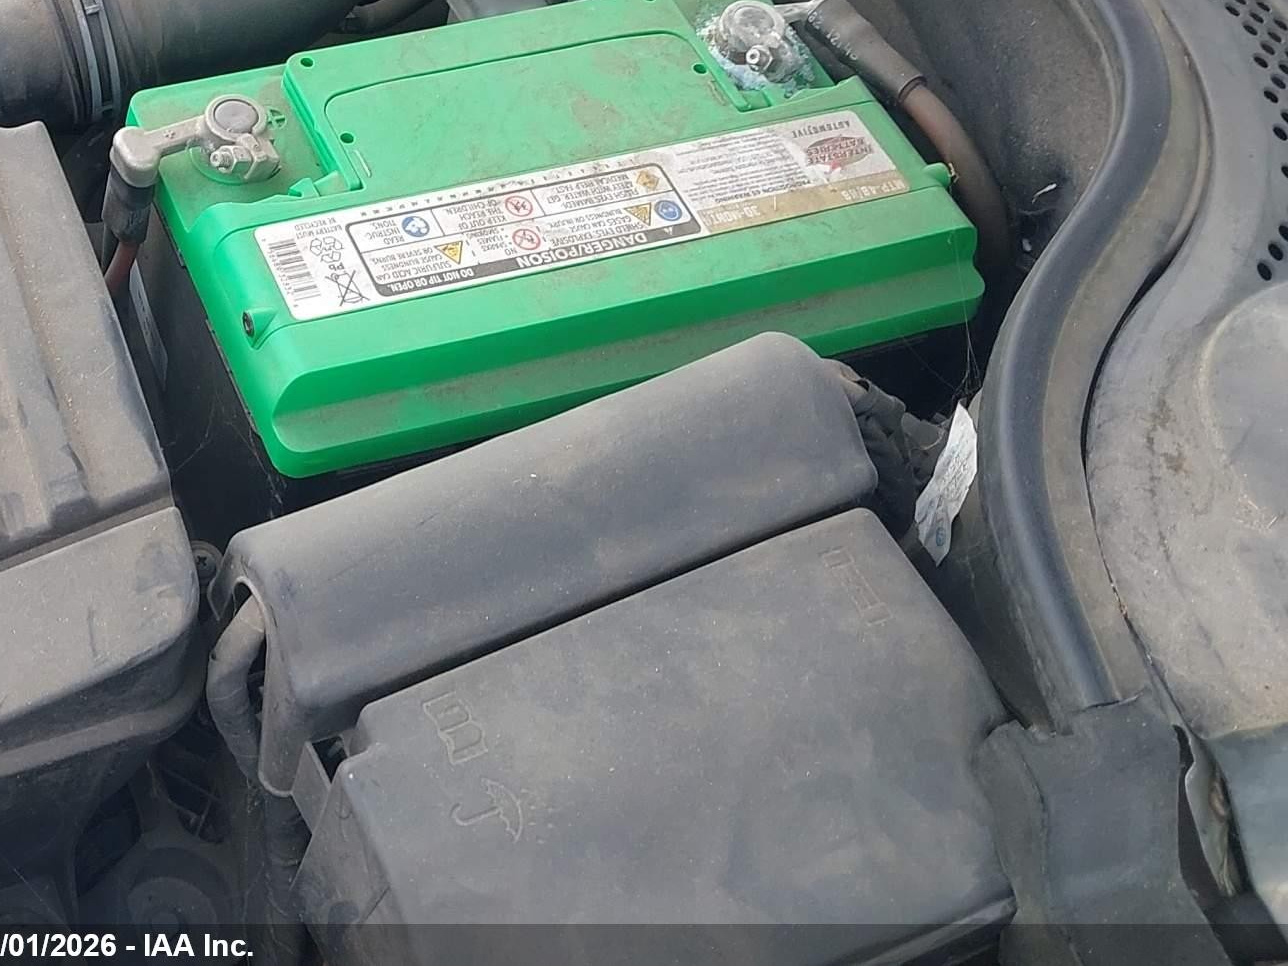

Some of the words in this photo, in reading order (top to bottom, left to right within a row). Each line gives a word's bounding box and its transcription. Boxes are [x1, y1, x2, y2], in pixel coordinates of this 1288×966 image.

[801, 144, 874, 167] INTERSTATE
[515, 230, 648, 268] DANGER/POISON
[327, 261, 345, 271] Pb
[386, 279, 414, 293] OPEN.
